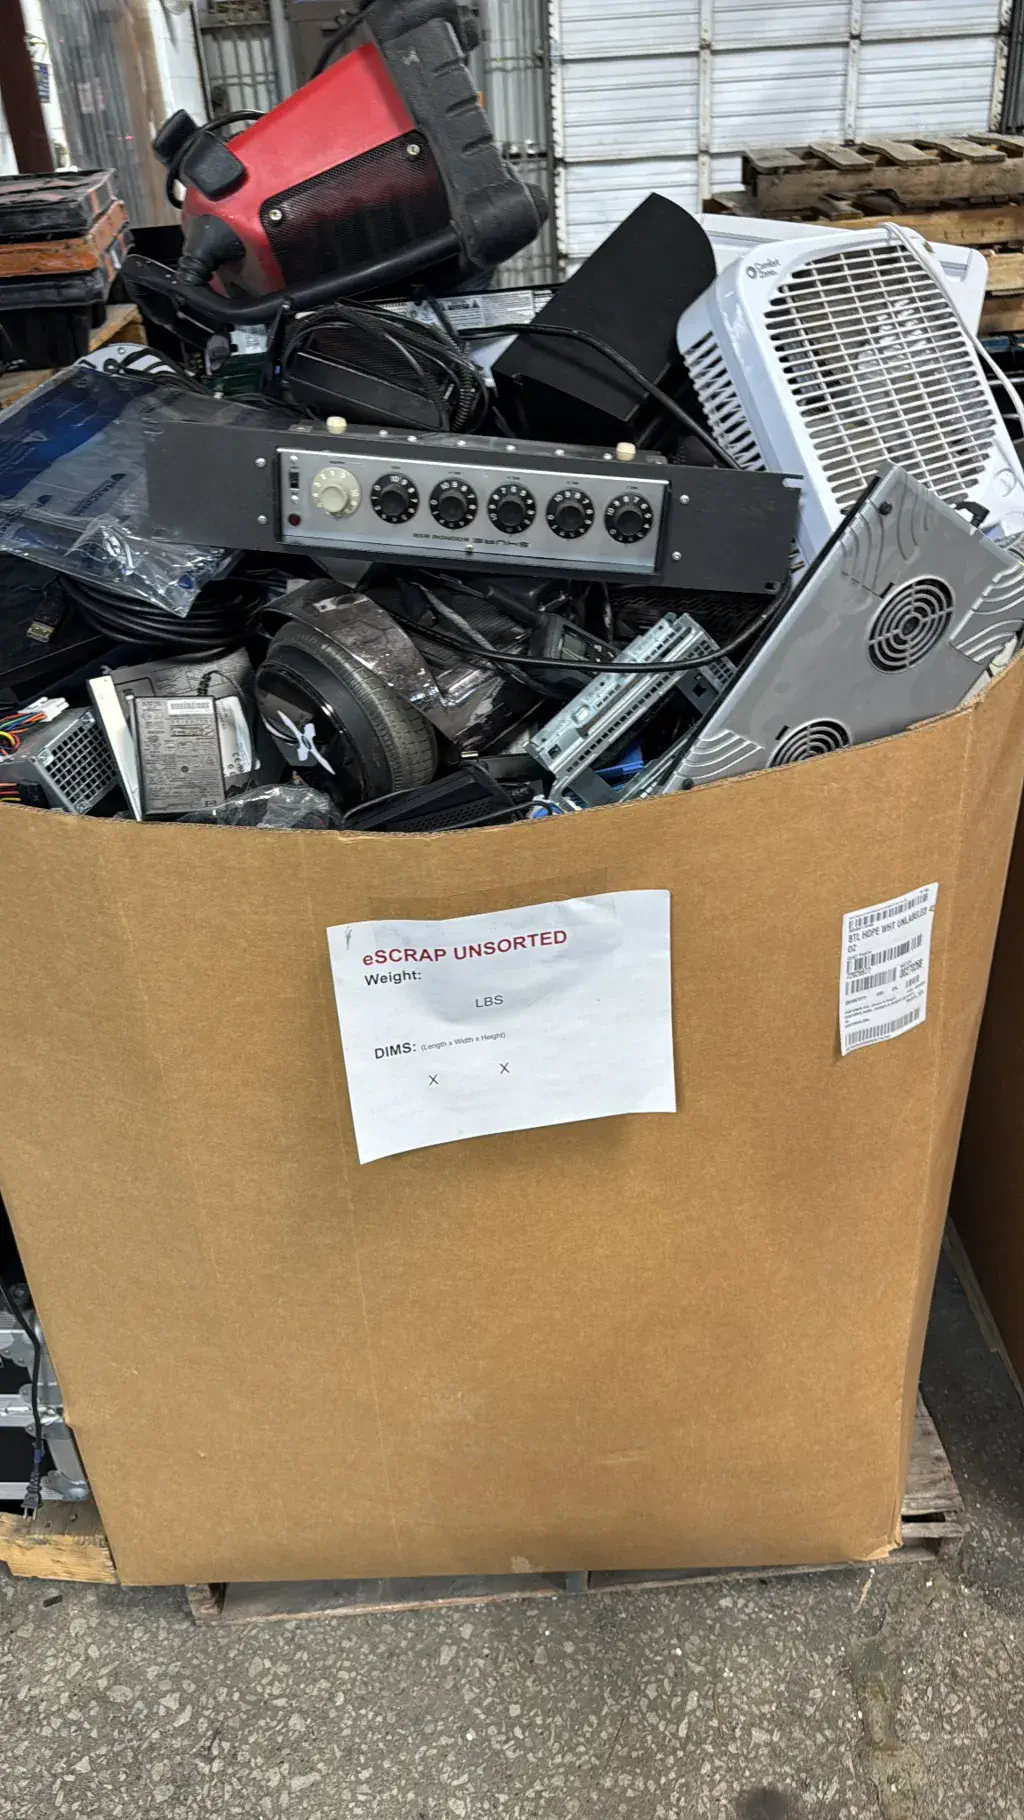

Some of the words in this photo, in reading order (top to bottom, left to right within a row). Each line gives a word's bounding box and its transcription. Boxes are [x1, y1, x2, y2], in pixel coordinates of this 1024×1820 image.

[473, 538, 530, 548] SHURE
[848, 933, 860, 943] BTL
[862, 926, 880, 939] HOPE
[362, 948, 447, 966] eSCRAP
[453, 930, 568, 960] UNSORTED
[364, 970, 422, 986] Weight:
[476, 995, 504, 1008] LBS
[374, 1042, 416, 1060] DIMS:
[420, 1040, 448, 1052] (Length
[454, 1036, 474, 1045] Width
[480, 1032, 506, 1041] Height)
[428, 1074, 439, 1086] X
[500, 1062, 510, 1074] X
